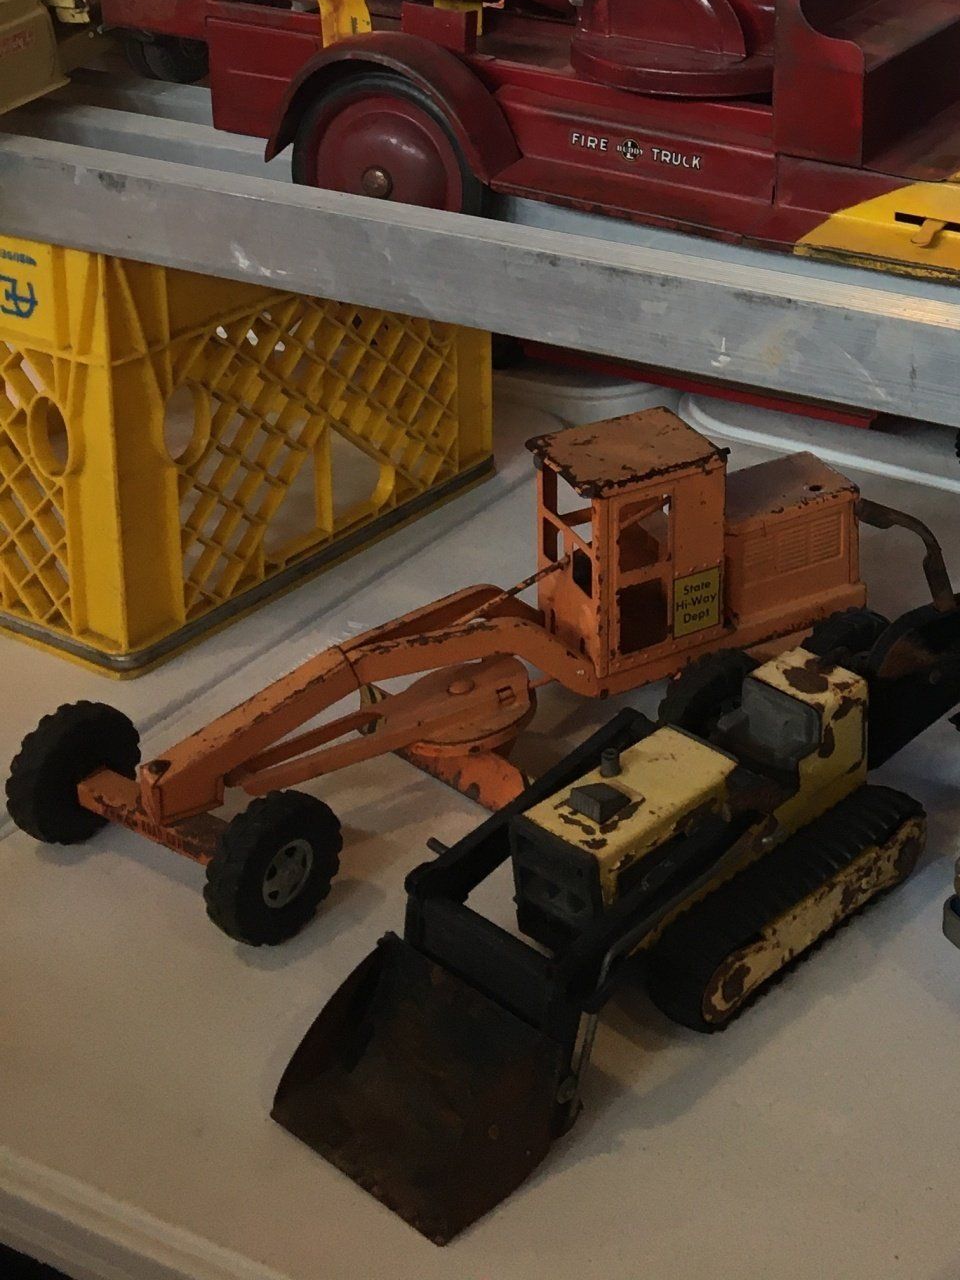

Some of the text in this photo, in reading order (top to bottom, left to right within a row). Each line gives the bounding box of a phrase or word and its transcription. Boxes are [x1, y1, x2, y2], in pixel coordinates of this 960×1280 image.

[571, 132, 609, 152] FIRE
[651, 148, 702, 170] TRUCK
[683, 581, 711, 596] State
[676, 593, 717, 611] Hi-Way
[683, 608, 710, 623] Dept
